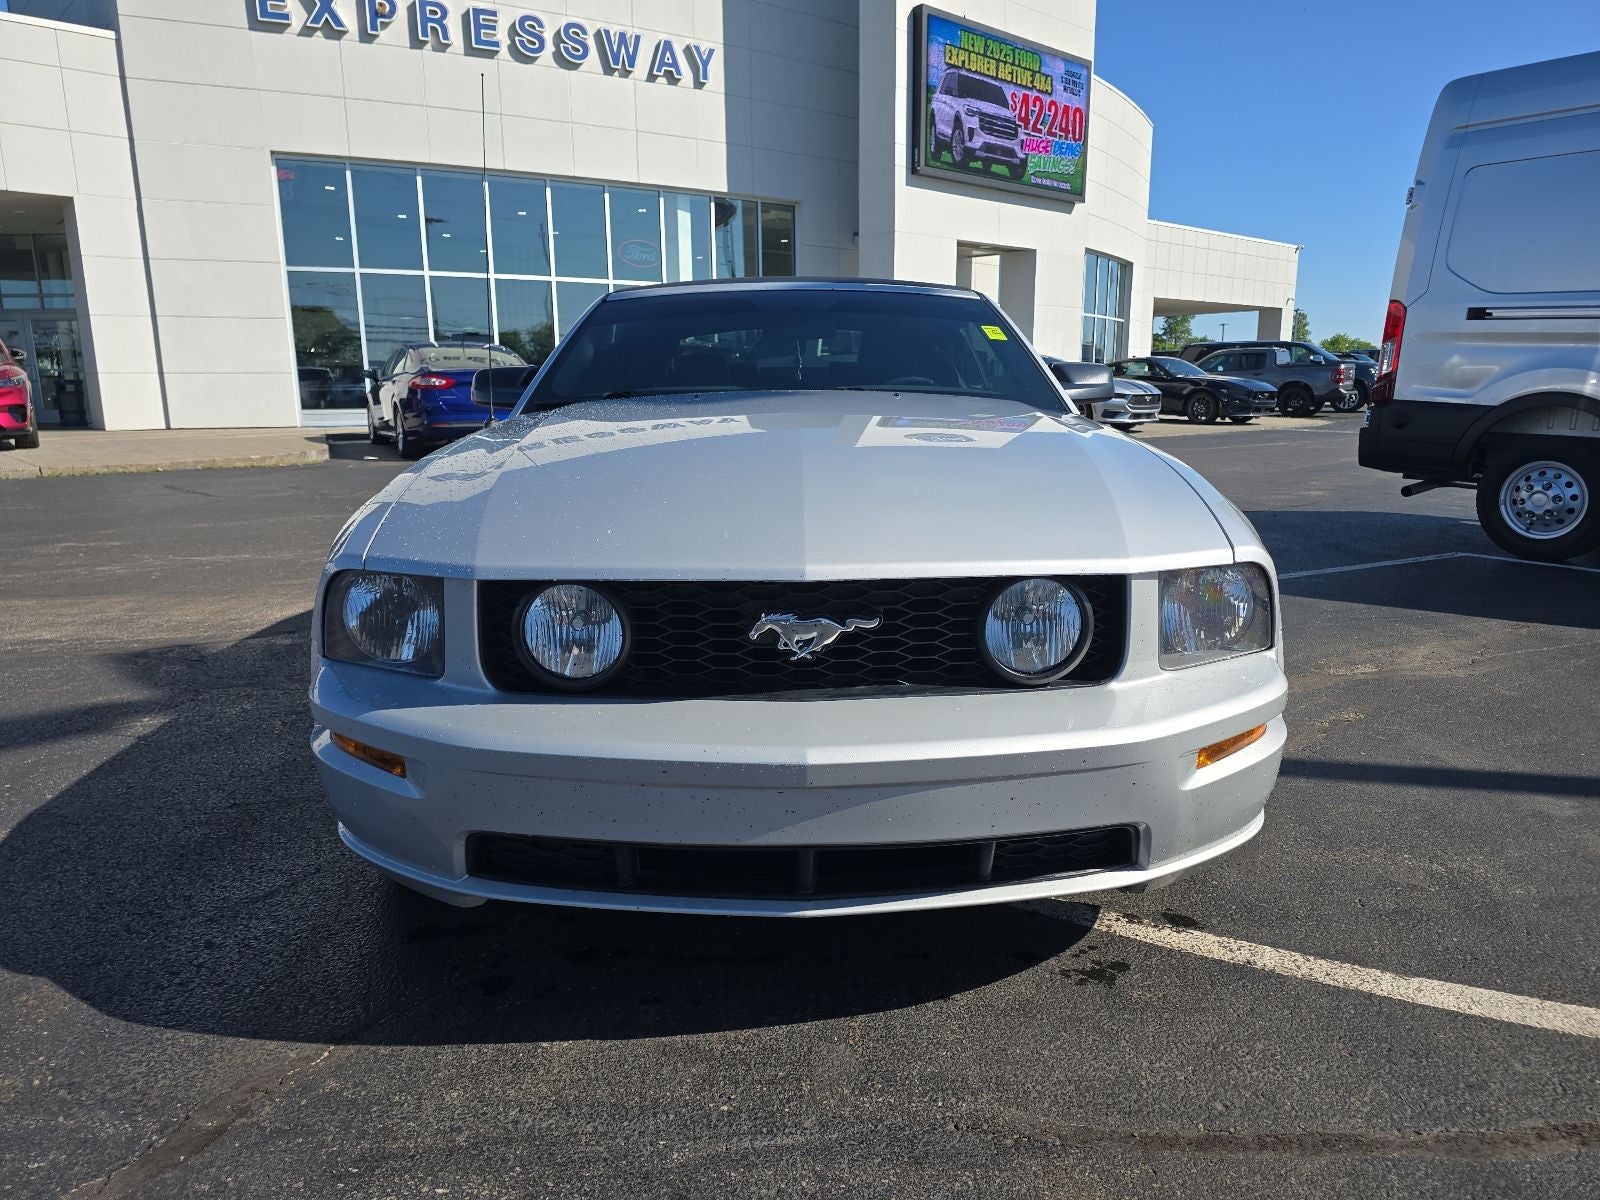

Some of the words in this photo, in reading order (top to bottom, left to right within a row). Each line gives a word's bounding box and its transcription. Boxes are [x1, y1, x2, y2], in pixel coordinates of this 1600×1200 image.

[254, 0, 717, 84] EXPRESSWAY
[960, 30, 985, 54] NEW
[986, 39, 1014, 62] 2025
[1014, 49, 1040, 71] FORD
[945, 45, 997, 77] EXPLORER
[998, 61, 1033, 87] ACTIVE
[1023, 138, 1052, 155] HUGE
[1052, 141, 1082, 158] DEMO
[622, 243, 658, 264] Ford
